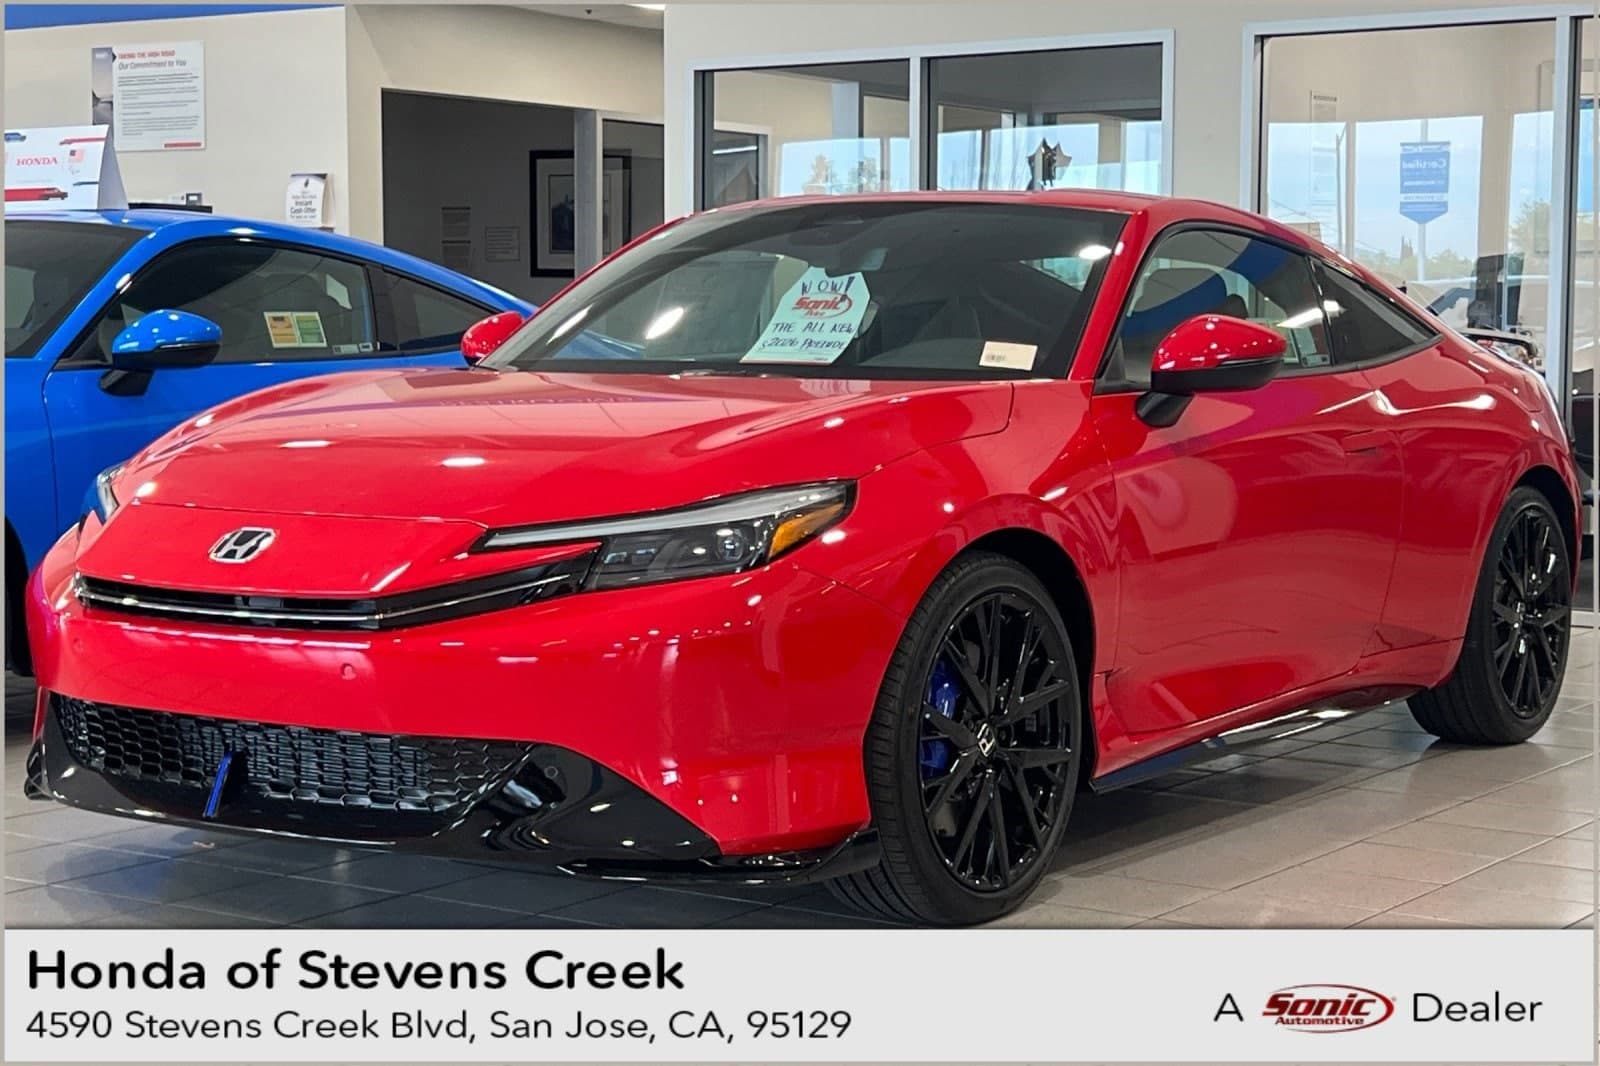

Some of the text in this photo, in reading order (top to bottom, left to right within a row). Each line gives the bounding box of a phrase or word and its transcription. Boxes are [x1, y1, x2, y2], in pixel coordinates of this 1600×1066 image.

[118, 62, 129, 70] Our
[129, 60, 167, 69] Commitment
[175, 59, 187, 67] You
[16, 157, 58, 166] HONDA
[792, 296, 845, 310] Sonic
[773, 322, 796, 333] THE
